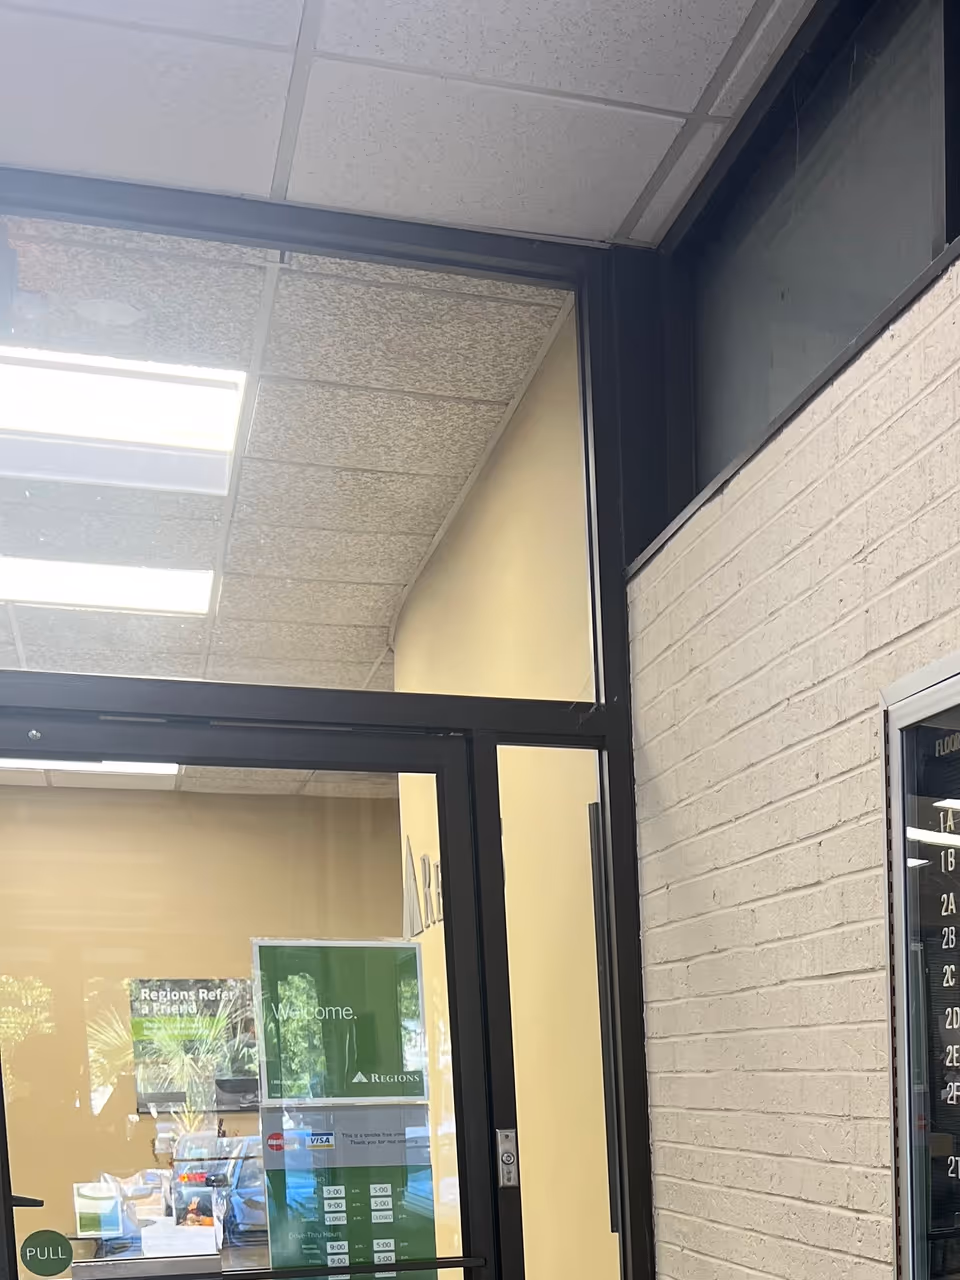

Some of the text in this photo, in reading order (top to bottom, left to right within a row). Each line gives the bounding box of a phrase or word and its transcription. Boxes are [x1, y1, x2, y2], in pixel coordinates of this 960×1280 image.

[936, 732, 960, 757] FLOOR
[939, 808, 954, 833] 1A
[940, 849, 955, 873] 1B
[941, 894, 956, 916] 2A
[942, 926, 956, 949] 2B
[943, 965, 956, 987] 2C
[141, 988, 234, 1003] Regions Refer
[153, 1002, 197, 1014] Friend
[271, 1003, 358, 1020] Welcome.
[946, 1045, 960, 1067] 2E
[310, 1137, 330, 1145] VISA
[26, 1246, 67, 1260] PULL
